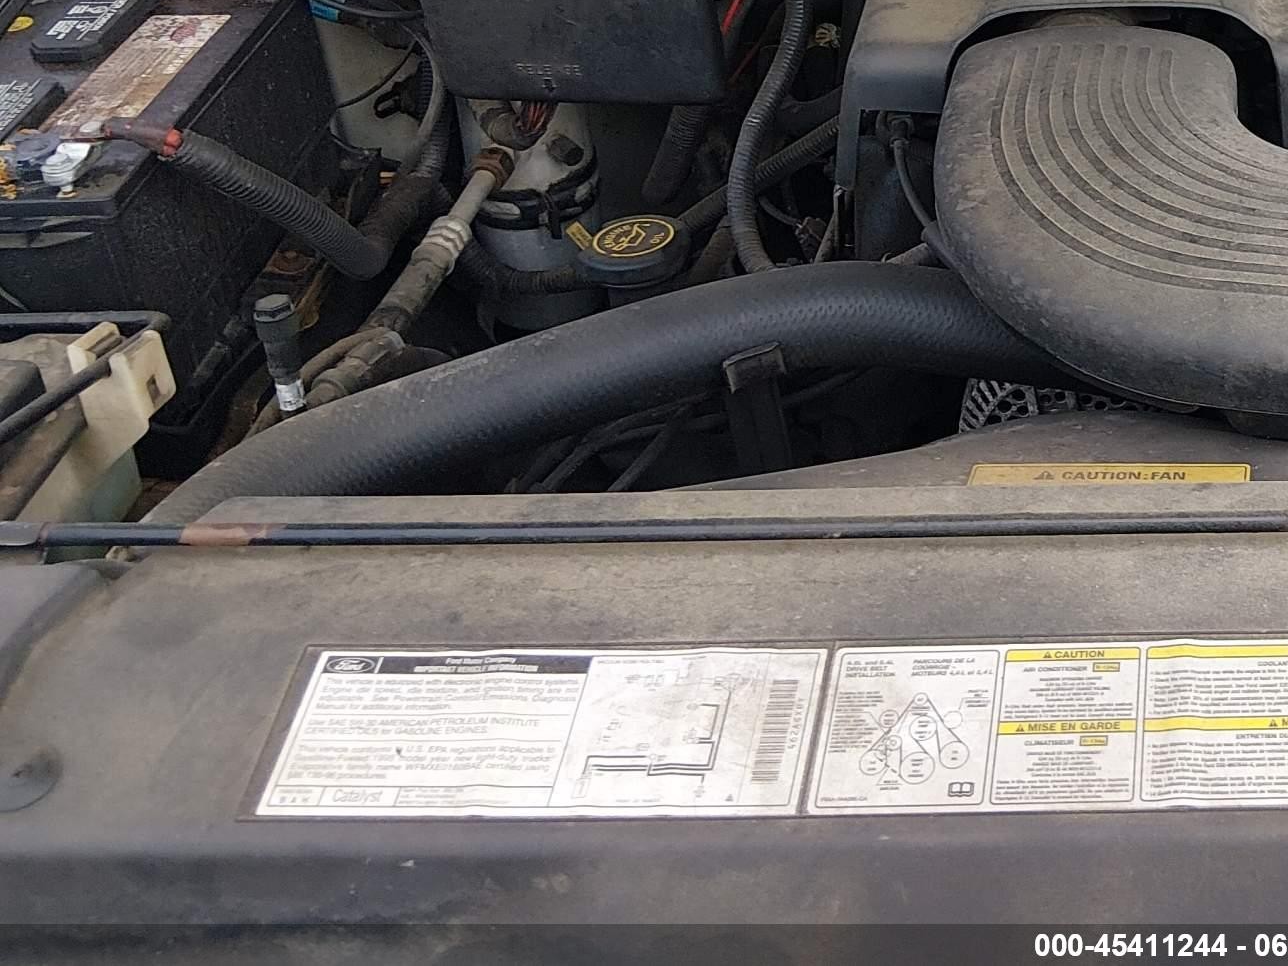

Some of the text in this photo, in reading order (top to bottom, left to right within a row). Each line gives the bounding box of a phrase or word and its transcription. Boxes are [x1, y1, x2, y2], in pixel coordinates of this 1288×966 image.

[650, 232, 666, 245] OIL
[1054, 650, 1105, 660] CAUTION
[1027, 722, 1121, 732] MISE EN GARDE
[333, 789, 383, 805] Catalyst
